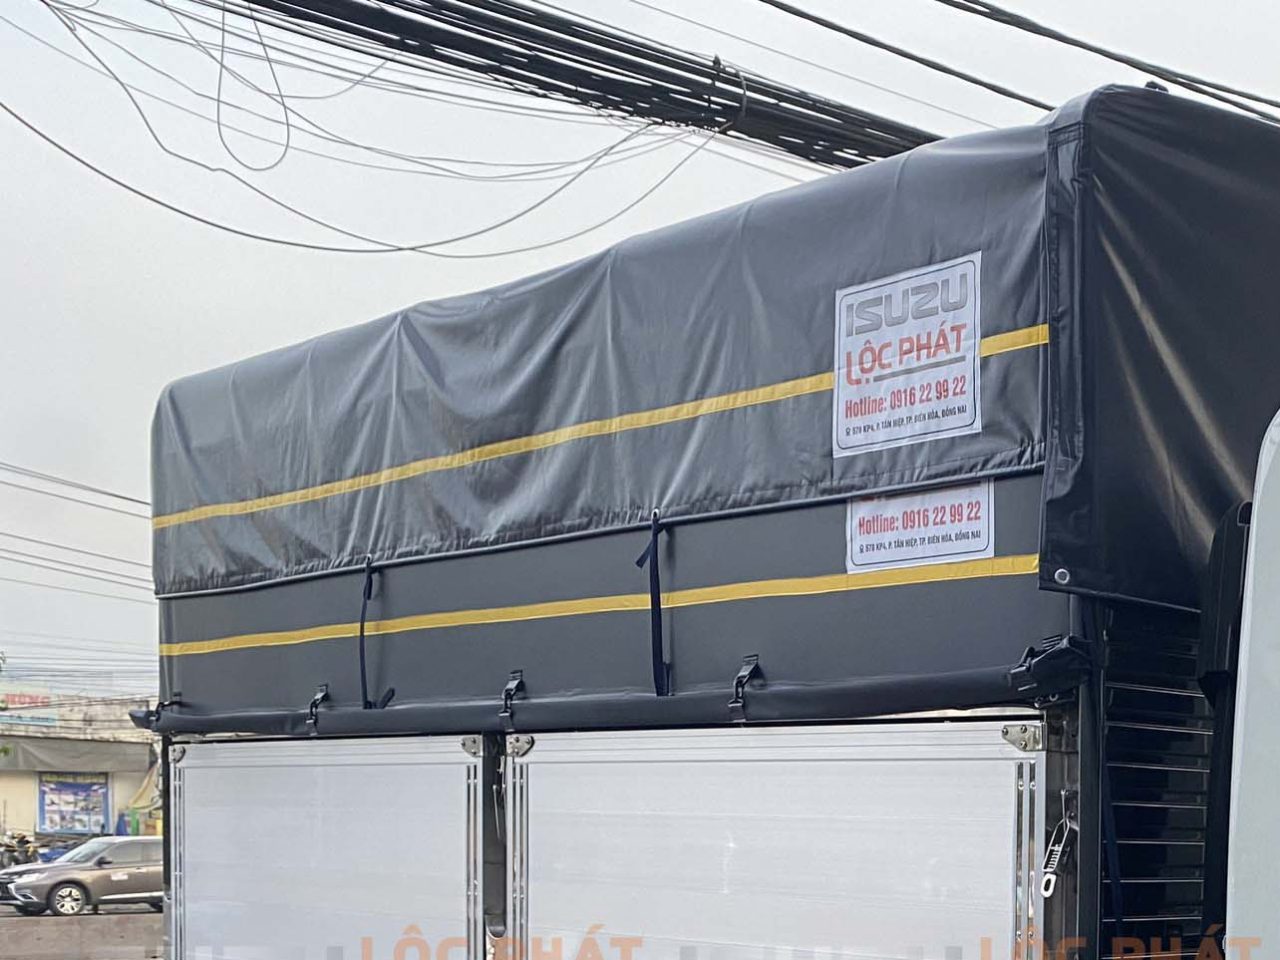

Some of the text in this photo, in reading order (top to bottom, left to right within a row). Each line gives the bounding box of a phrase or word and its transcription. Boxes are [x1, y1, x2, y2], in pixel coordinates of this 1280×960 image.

[846, 273, 968, 337] ISUZU
[846, 320, 967, 385] LỘC PHÁT
[845, 375, 966, 419] Hotline: 0916 22 99 22
[858, 501, 981, 536] Hotline: 0916 22 99 22
